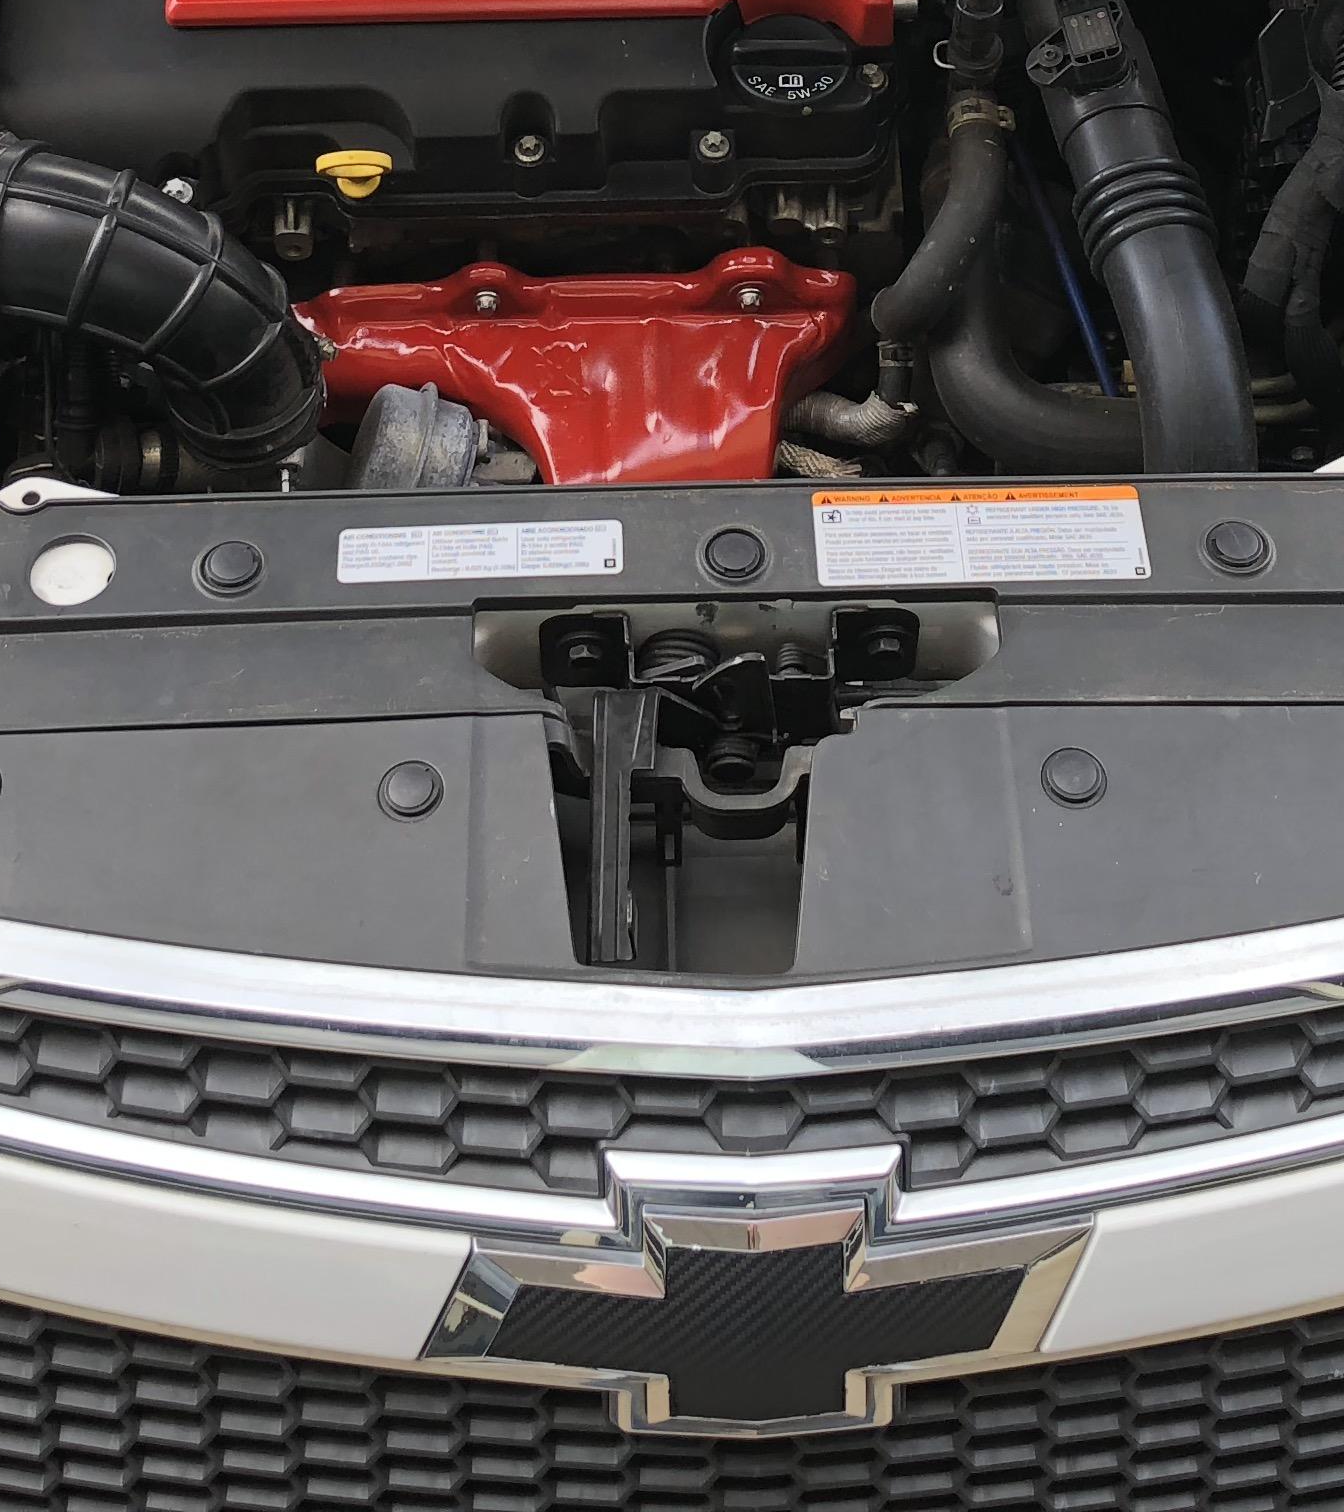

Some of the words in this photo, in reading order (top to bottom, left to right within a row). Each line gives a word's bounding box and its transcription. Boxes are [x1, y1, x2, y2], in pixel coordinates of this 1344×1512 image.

[748, 76, 776, 97] SAE
[787, 76, 834, 100] 5W-30
[834, 495, 870, 503] WARNING
